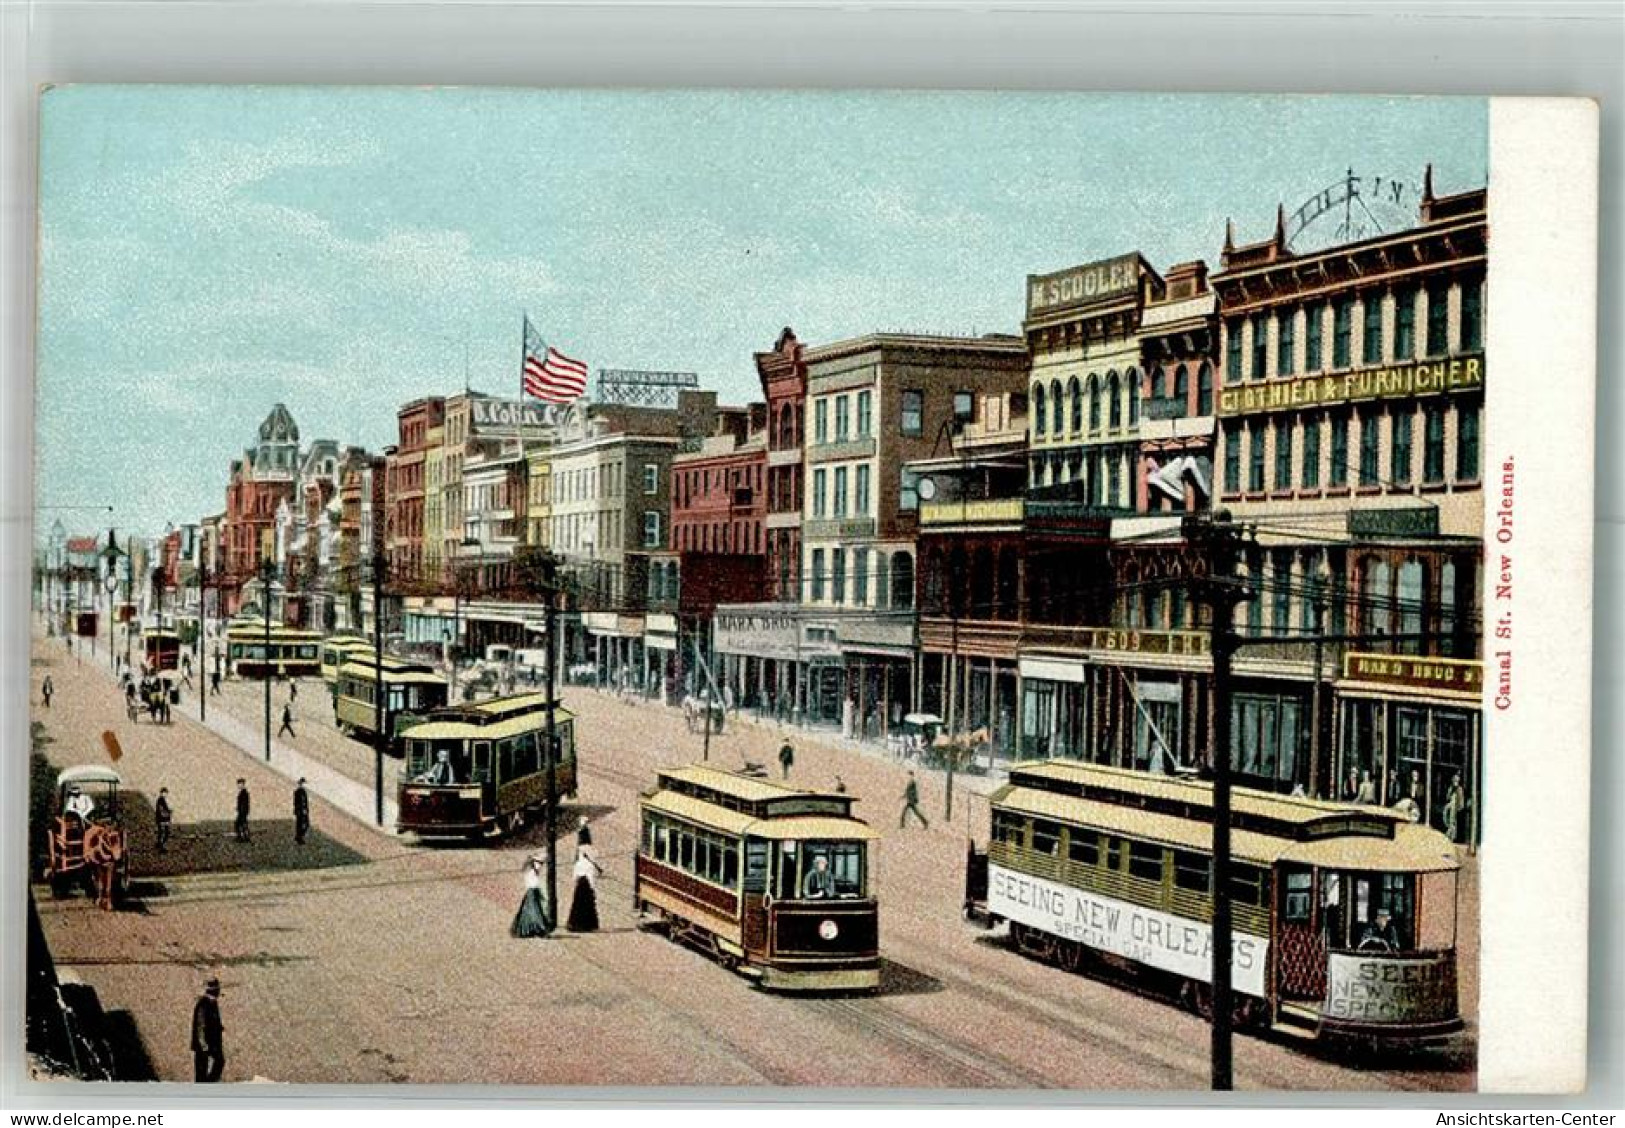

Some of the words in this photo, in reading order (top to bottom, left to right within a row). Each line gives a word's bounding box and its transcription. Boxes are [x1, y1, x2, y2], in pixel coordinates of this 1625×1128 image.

[1497, 455, 1514, 543] Orleans.
[1497, 555, 1512, 599] New
[1496, 611, 1512, 639] St.
[1495, 650, 1512, 710] Canal
[995, 872, 1065, 917] SEEING
[1075, 896, 1121, 933] NEW
[1131, 913, 1256, 970] ORLEAS
